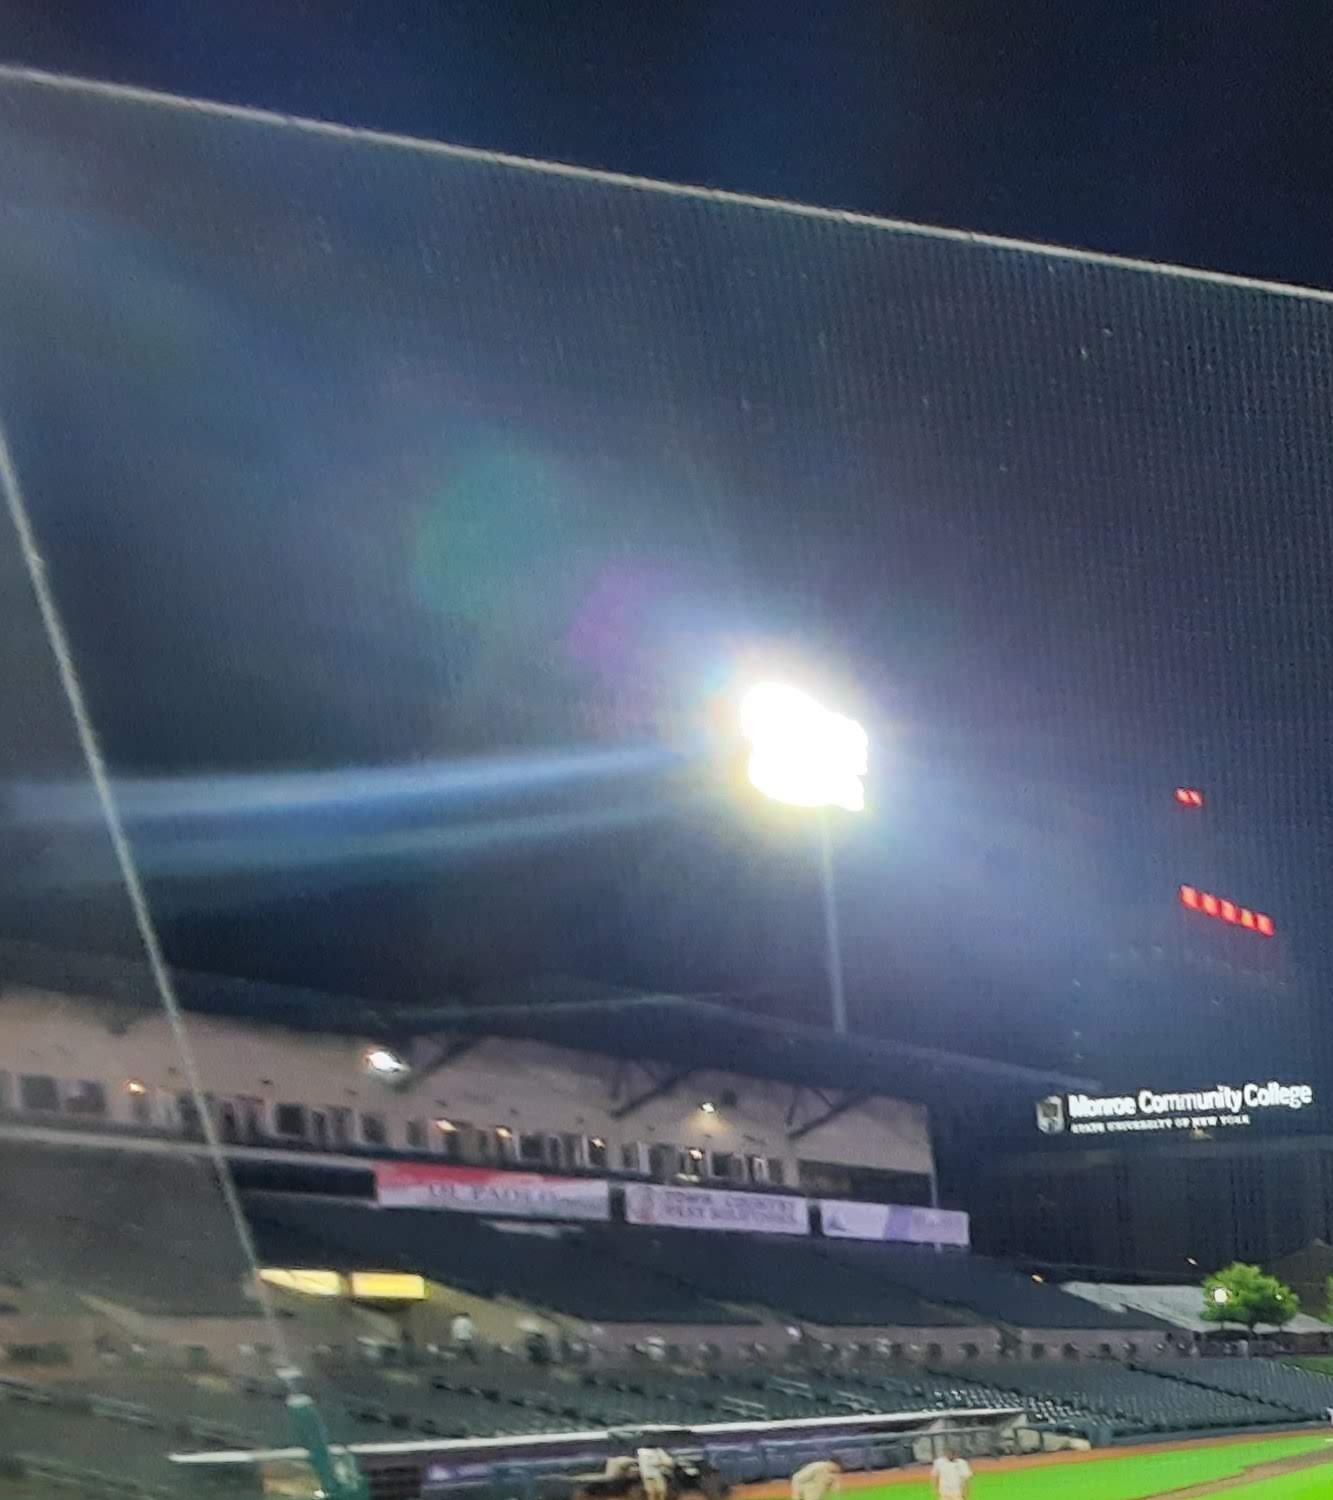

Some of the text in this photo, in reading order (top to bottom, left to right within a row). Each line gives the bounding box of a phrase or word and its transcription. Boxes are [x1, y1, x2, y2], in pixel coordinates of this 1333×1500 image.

[1068, 1081, 1312, 1118] Monroe Community College
